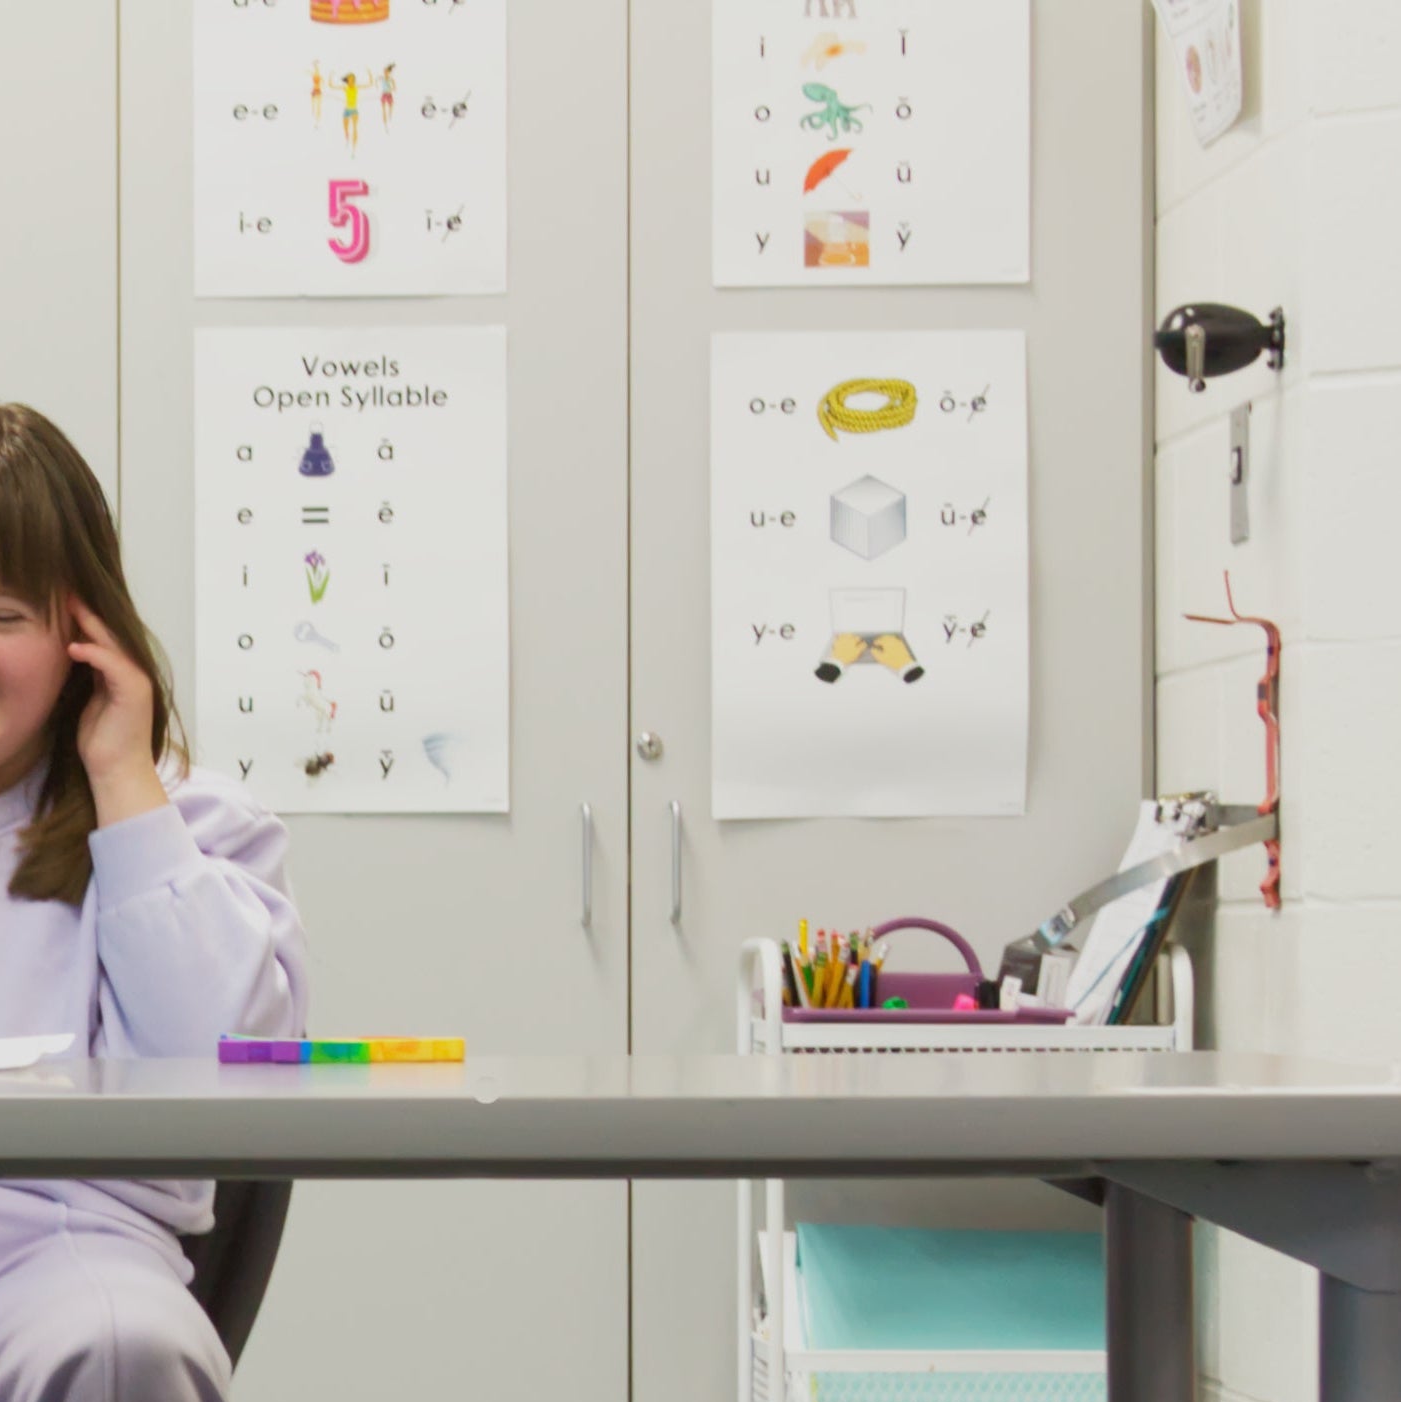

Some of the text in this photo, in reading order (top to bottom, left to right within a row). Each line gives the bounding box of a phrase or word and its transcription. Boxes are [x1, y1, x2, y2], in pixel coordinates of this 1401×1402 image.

[754, 105, 771, 122] o
[755, 168, 771, 186] u
[238, 211, 273, 234] i-e
[755, 232, 770, 254] y
[301, 354, 400, 378] Vowels
[253, 384, 448, 413] Open Syllable
[749, 397, 797, 415] o-e
[236, 444, 254, 462] a
[236, 507, 254, 525] e
[750, 510, 796, 528] u-e
[237, 633, 254, 651] o
[752, 623, 796, 646] y-e
[238, 696, 254, 714] u
[237, 758, 254, 782] y
